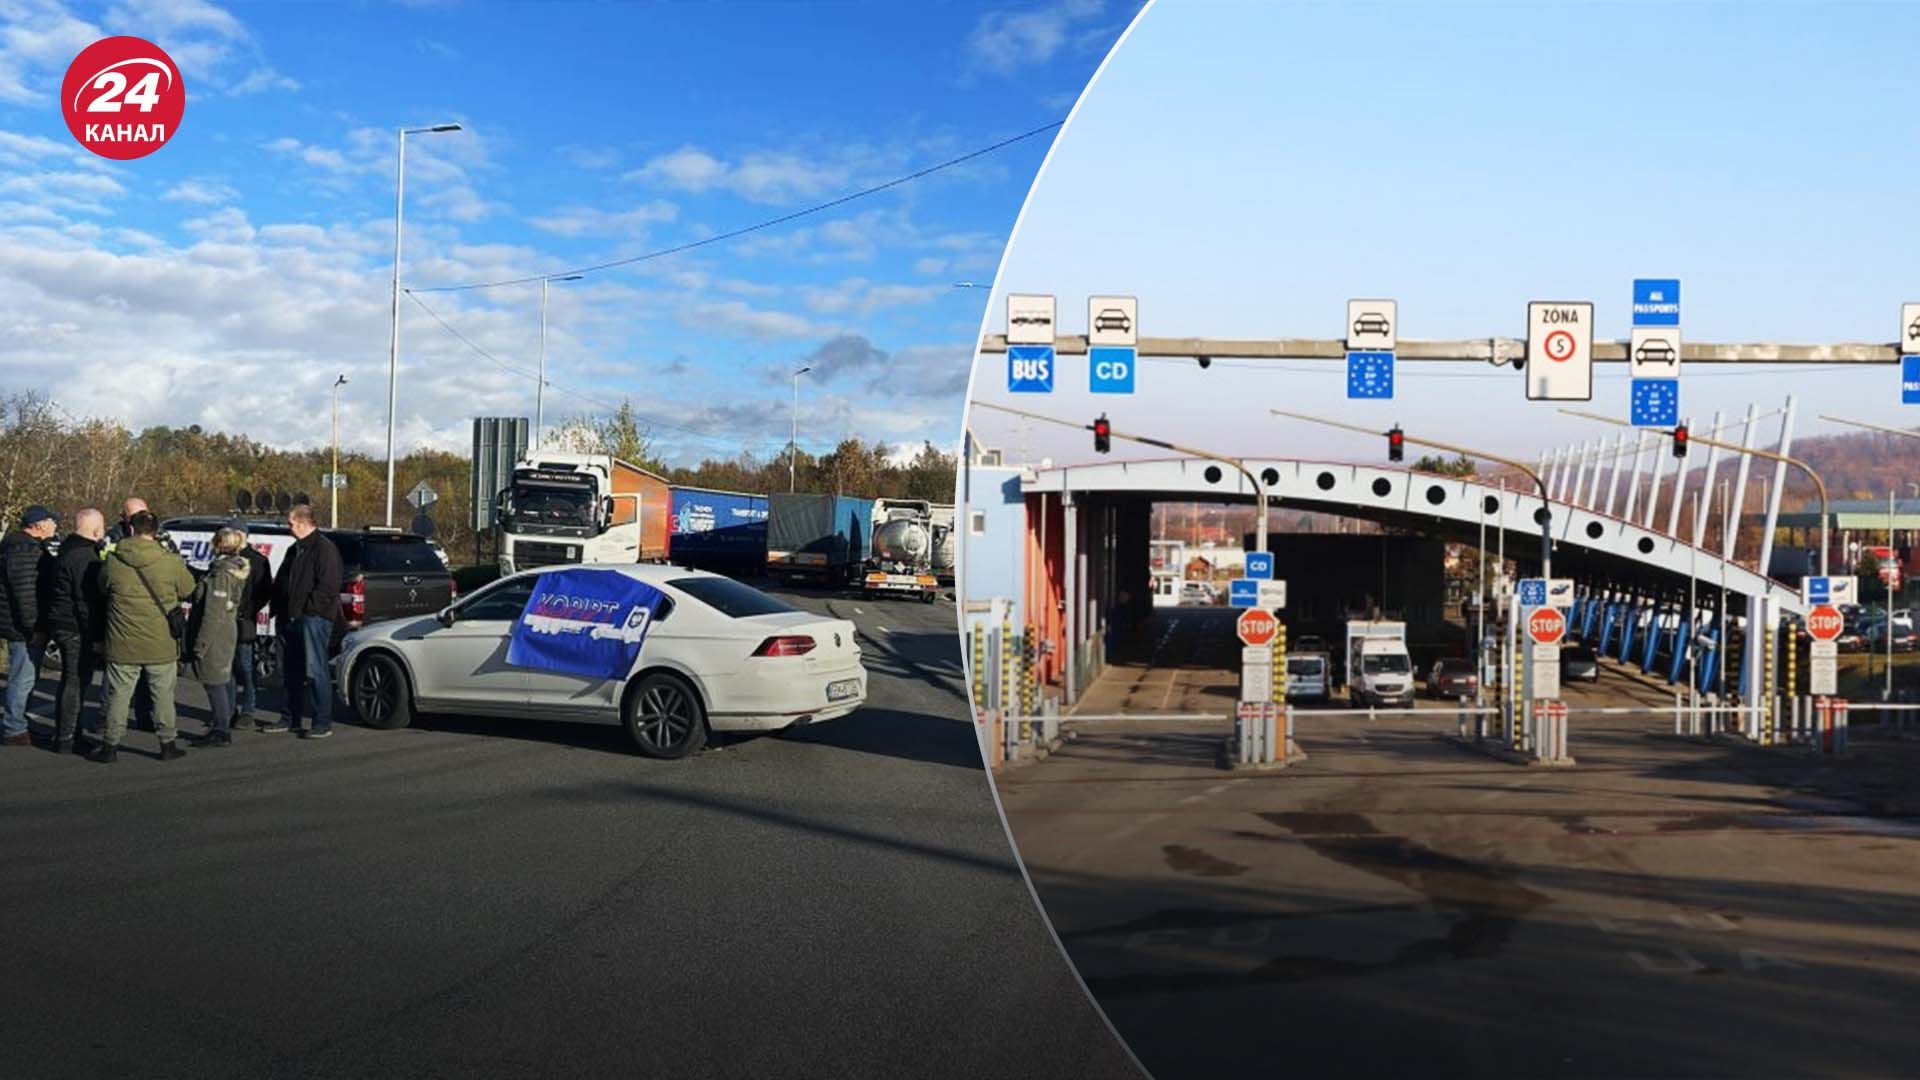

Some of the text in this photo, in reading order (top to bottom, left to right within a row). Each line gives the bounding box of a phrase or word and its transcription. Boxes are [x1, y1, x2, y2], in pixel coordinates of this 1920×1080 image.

[1556, 338, 1565, 353] 5
[1012, 359, 1049, 380] BUS
[1096, 361, 1128, 380] CD
[1241, 620, 1274, 635] STOP
[1531, 619, 1563, 633] STOP
[1810, 616, 1841, 630] STOP
